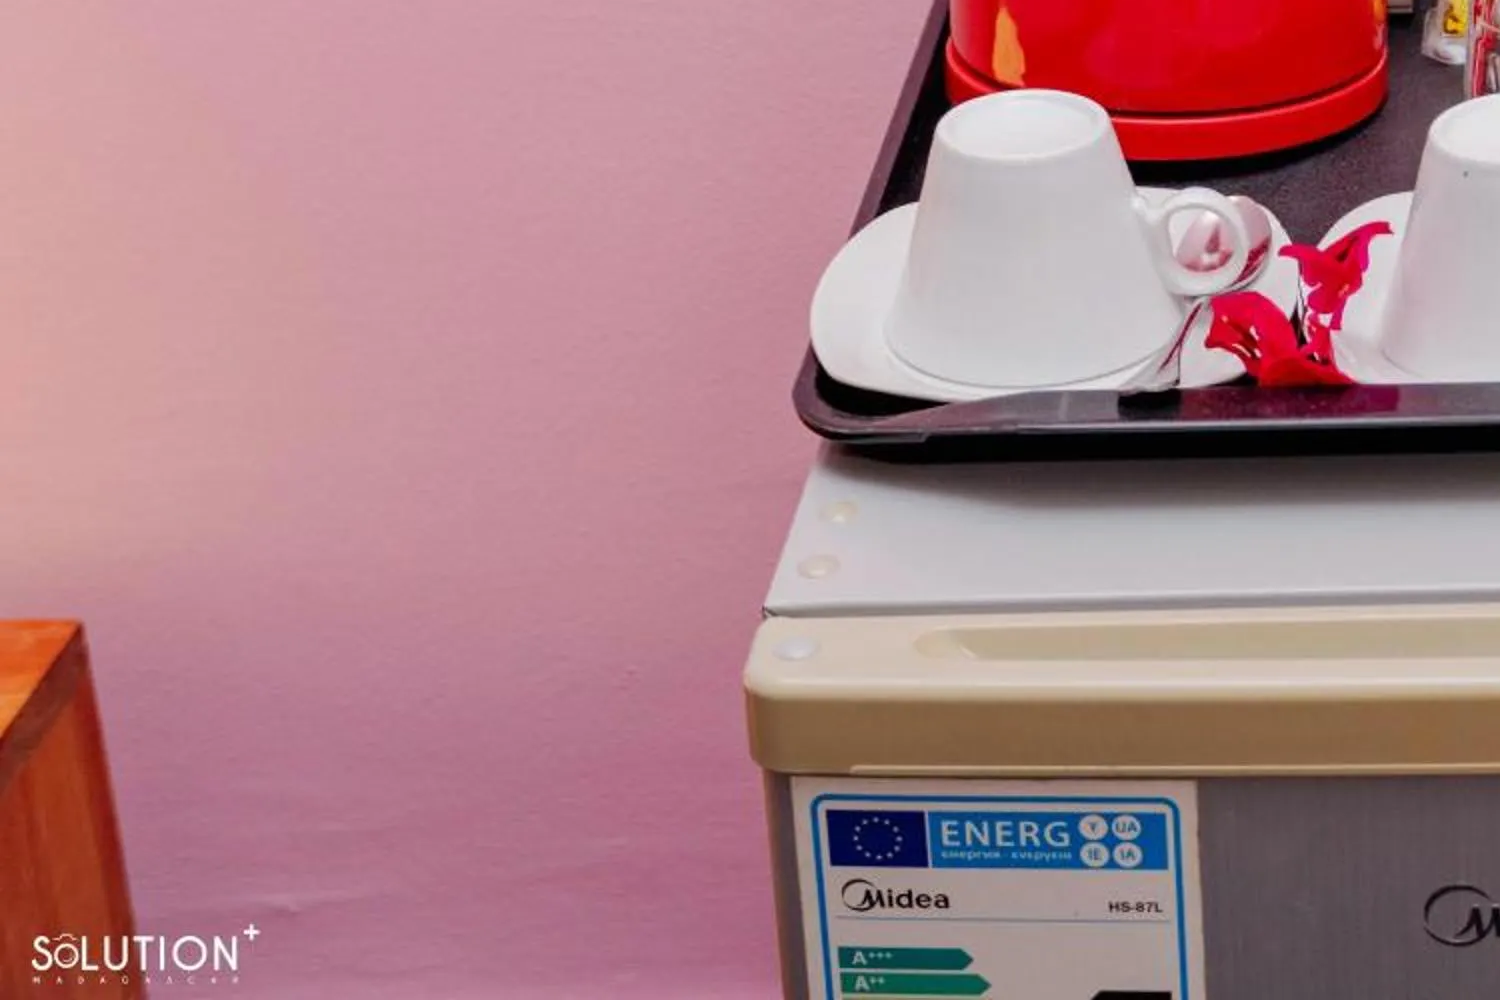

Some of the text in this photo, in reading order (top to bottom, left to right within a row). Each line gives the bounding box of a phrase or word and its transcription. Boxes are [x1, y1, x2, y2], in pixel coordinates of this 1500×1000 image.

[941, 820, 1071, 847] ENERG
[846, 881, 950, 911] Midea
[1108, 901, 1163, 914] HS-87L
